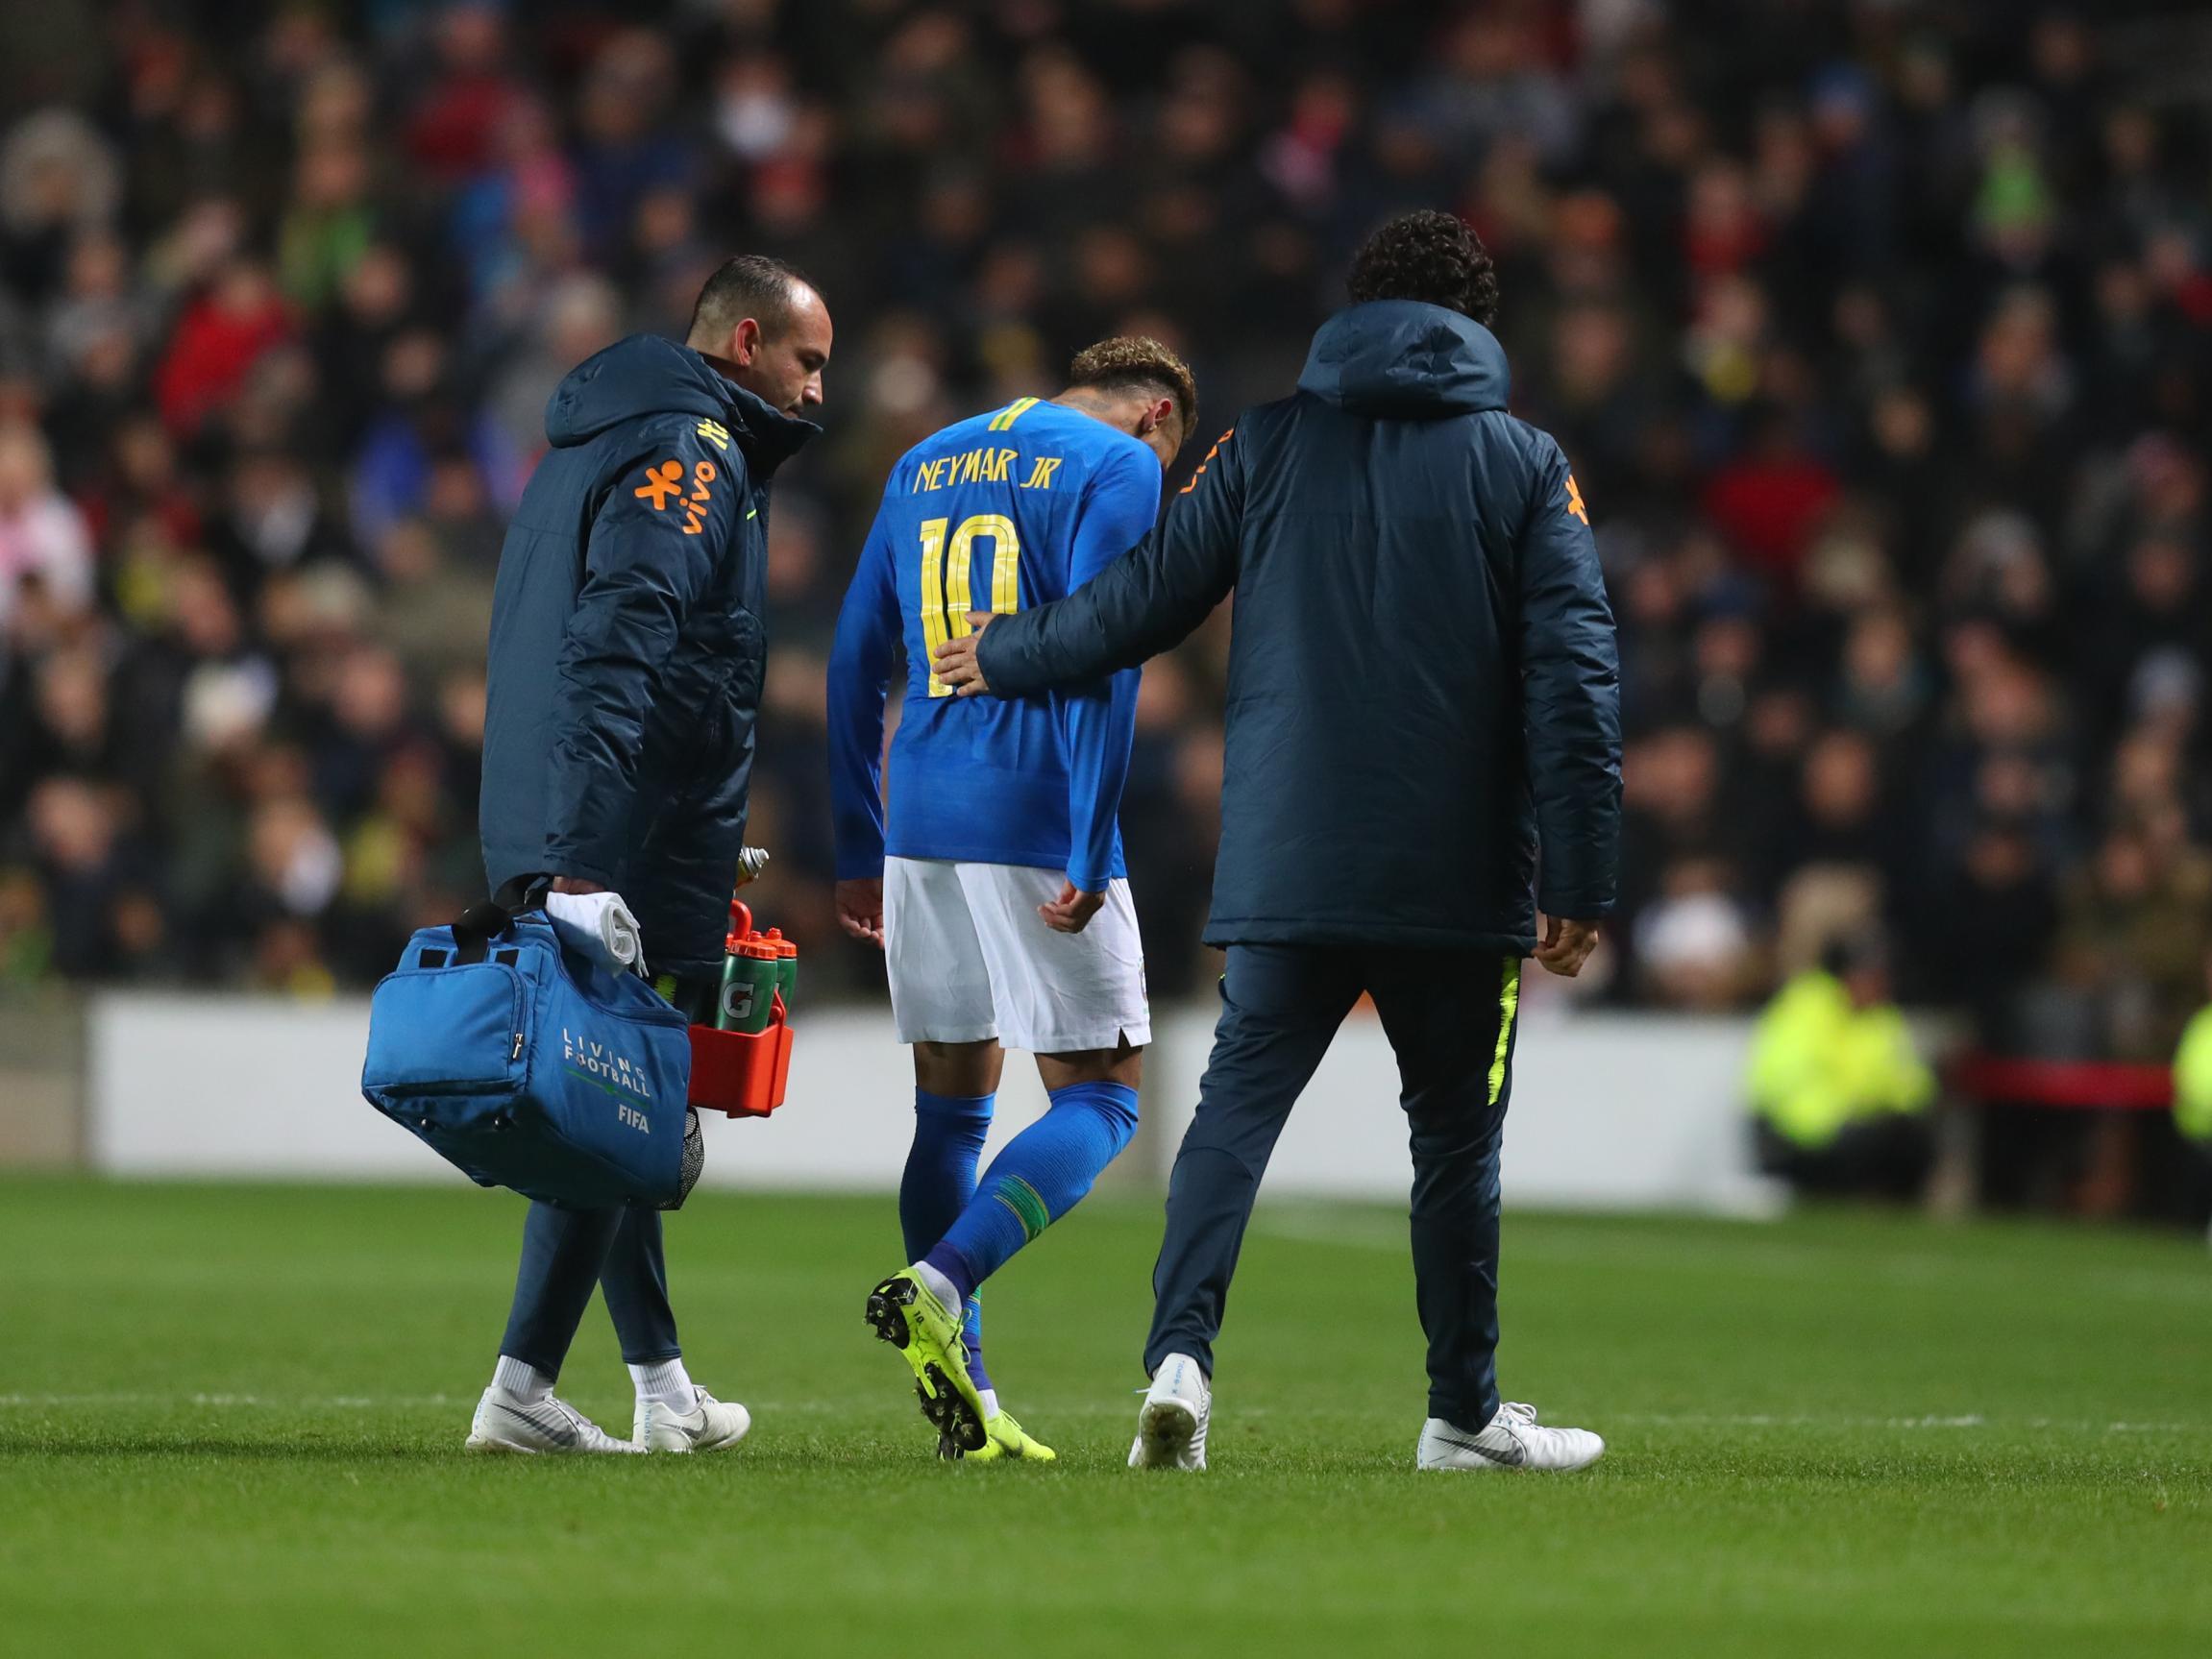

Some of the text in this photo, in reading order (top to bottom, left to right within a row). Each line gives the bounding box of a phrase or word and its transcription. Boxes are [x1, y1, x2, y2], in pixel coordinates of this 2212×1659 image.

[913, 447, 1063, 494] NEYMAR JR
[682, 460, 717, 535] vivo
[920, 514, 1020, 697] 10
[723, 982, 754, 1019] G
[562, 1027, 647, 1083] LIVING
[618, 1103, 651, 1134] FIFA
